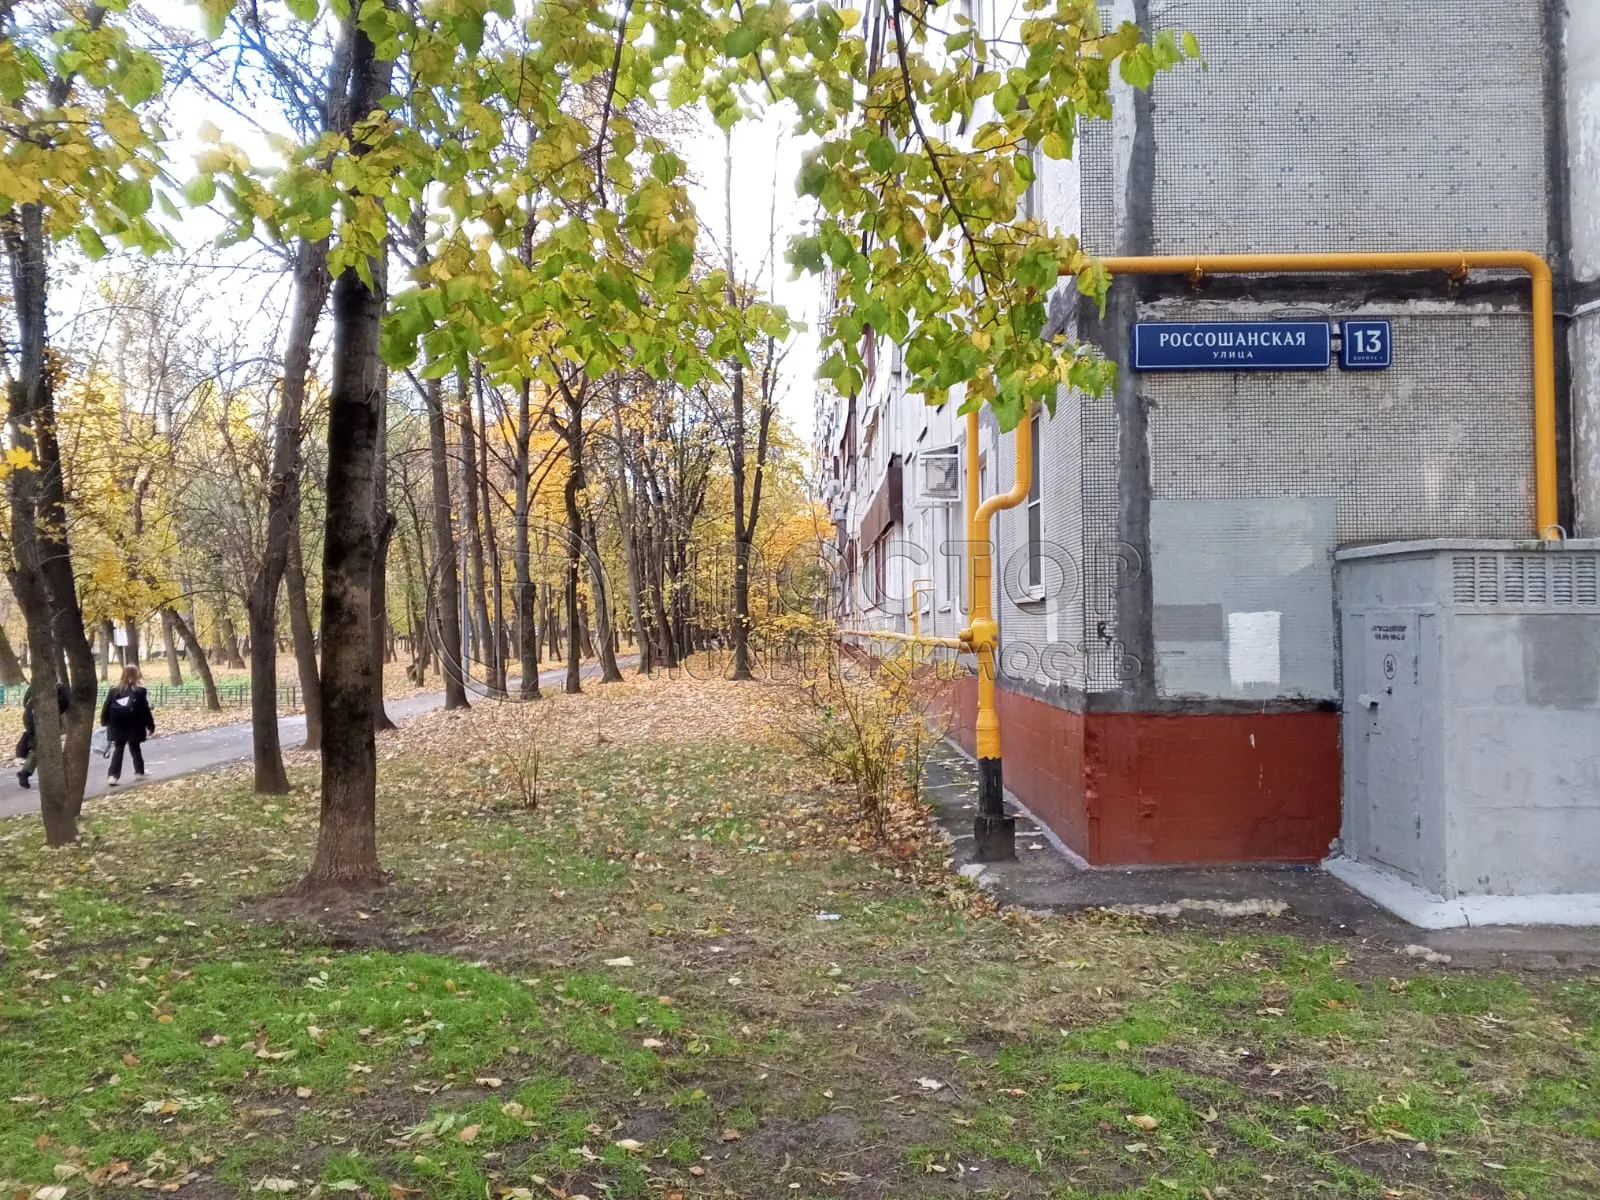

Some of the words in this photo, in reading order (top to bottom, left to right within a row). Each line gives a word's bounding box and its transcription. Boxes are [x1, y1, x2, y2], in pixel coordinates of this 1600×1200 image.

[1159, 331, 1307, 347] РОССОШАНСКАЯ
[1353, 330, 1382, 353] 13
[1212, 350, 1255, 360] УЛИЦА
